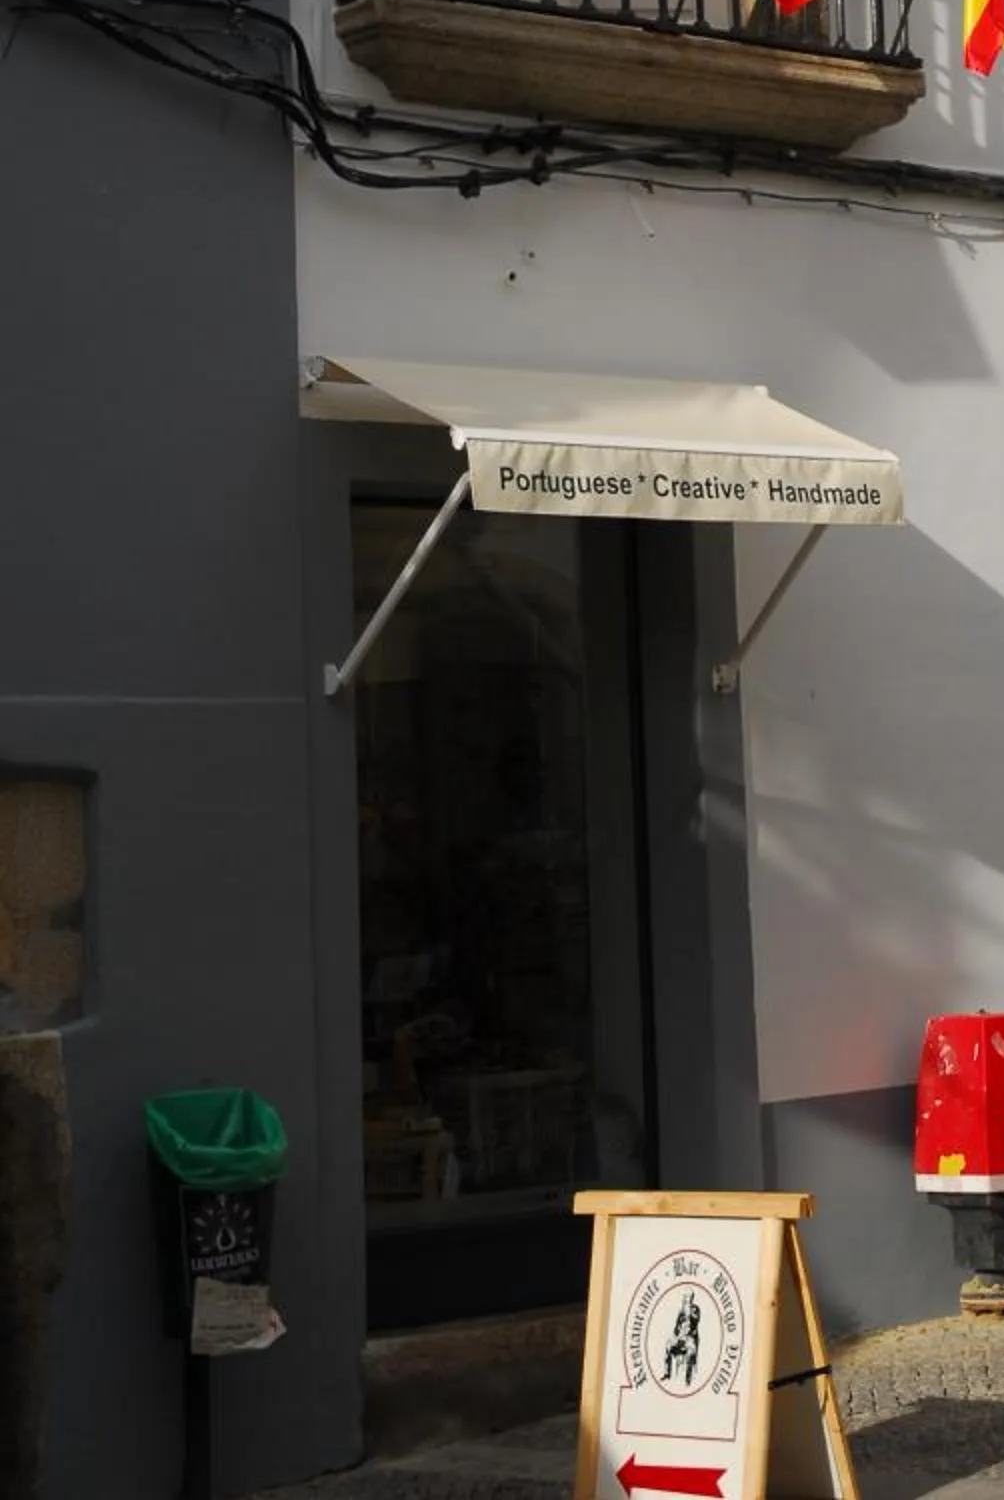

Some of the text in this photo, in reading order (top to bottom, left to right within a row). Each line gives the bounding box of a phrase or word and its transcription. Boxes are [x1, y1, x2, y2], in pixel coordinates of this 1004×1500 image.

[500, 466, 881, 505] Portuguese Creative Handmade
